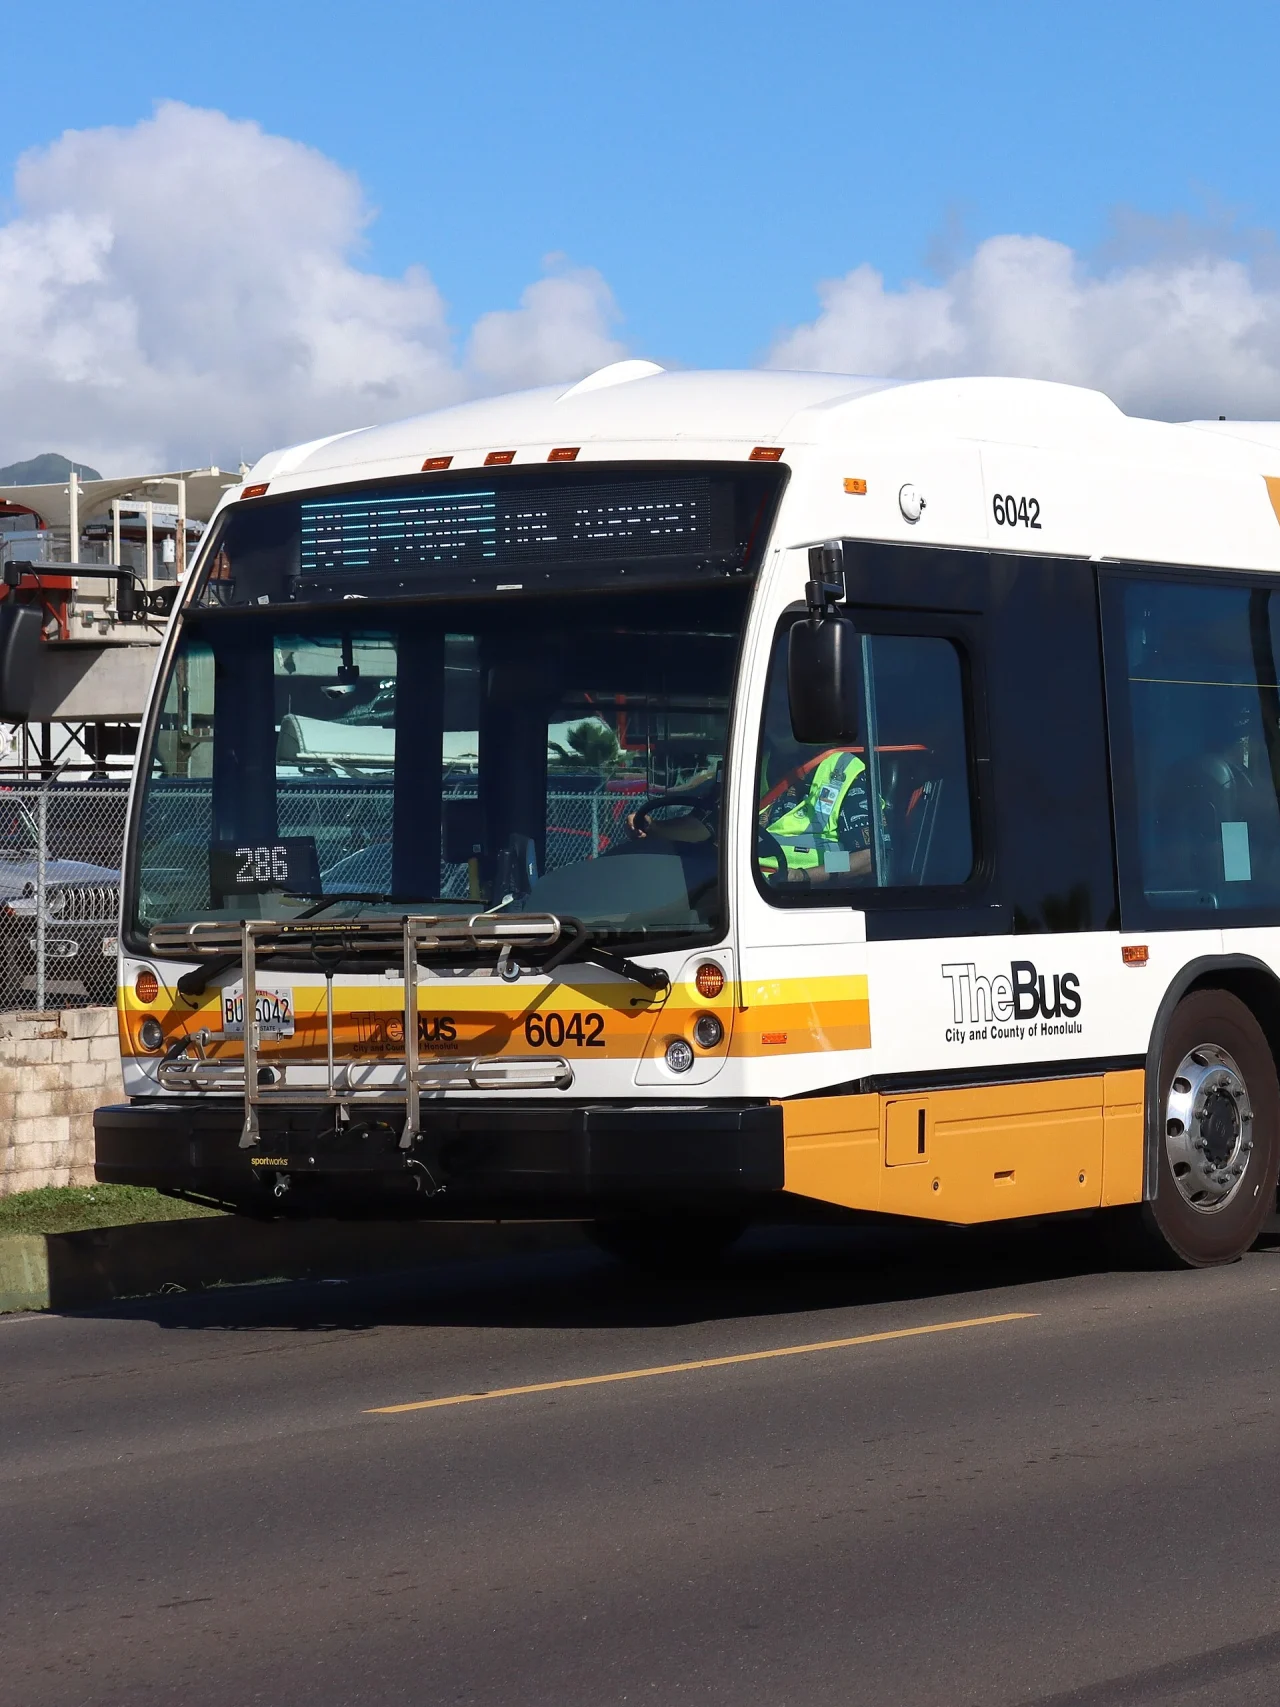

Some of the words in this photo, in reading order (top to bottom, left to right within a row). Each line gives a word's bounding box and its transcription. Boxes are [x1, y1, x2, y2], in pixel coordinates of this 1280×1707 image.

[993, 493, 1042, 529] 6042
[235, 846, 288, 882] 286
[941, 960, 1082, 1024] TheBus
[525, 1013, 605, 1047] 6042
[946, 1028, 966, 1044] City
[969, 1027, 987, 1040] and
[990, 1025, 1025, 1040] County
[1028, 1023, 1038, 1037] of
[1041, 1021, 1082, 1036] Honolulu
[353, 1045, 368, 1054] City
[370, 1044, 384, 1052] and
[386, 1043, 405, 1052] Coun
[424, 1042, 459, 1050] Honolulu
[251, 1156, 288, 1166] sportworks
